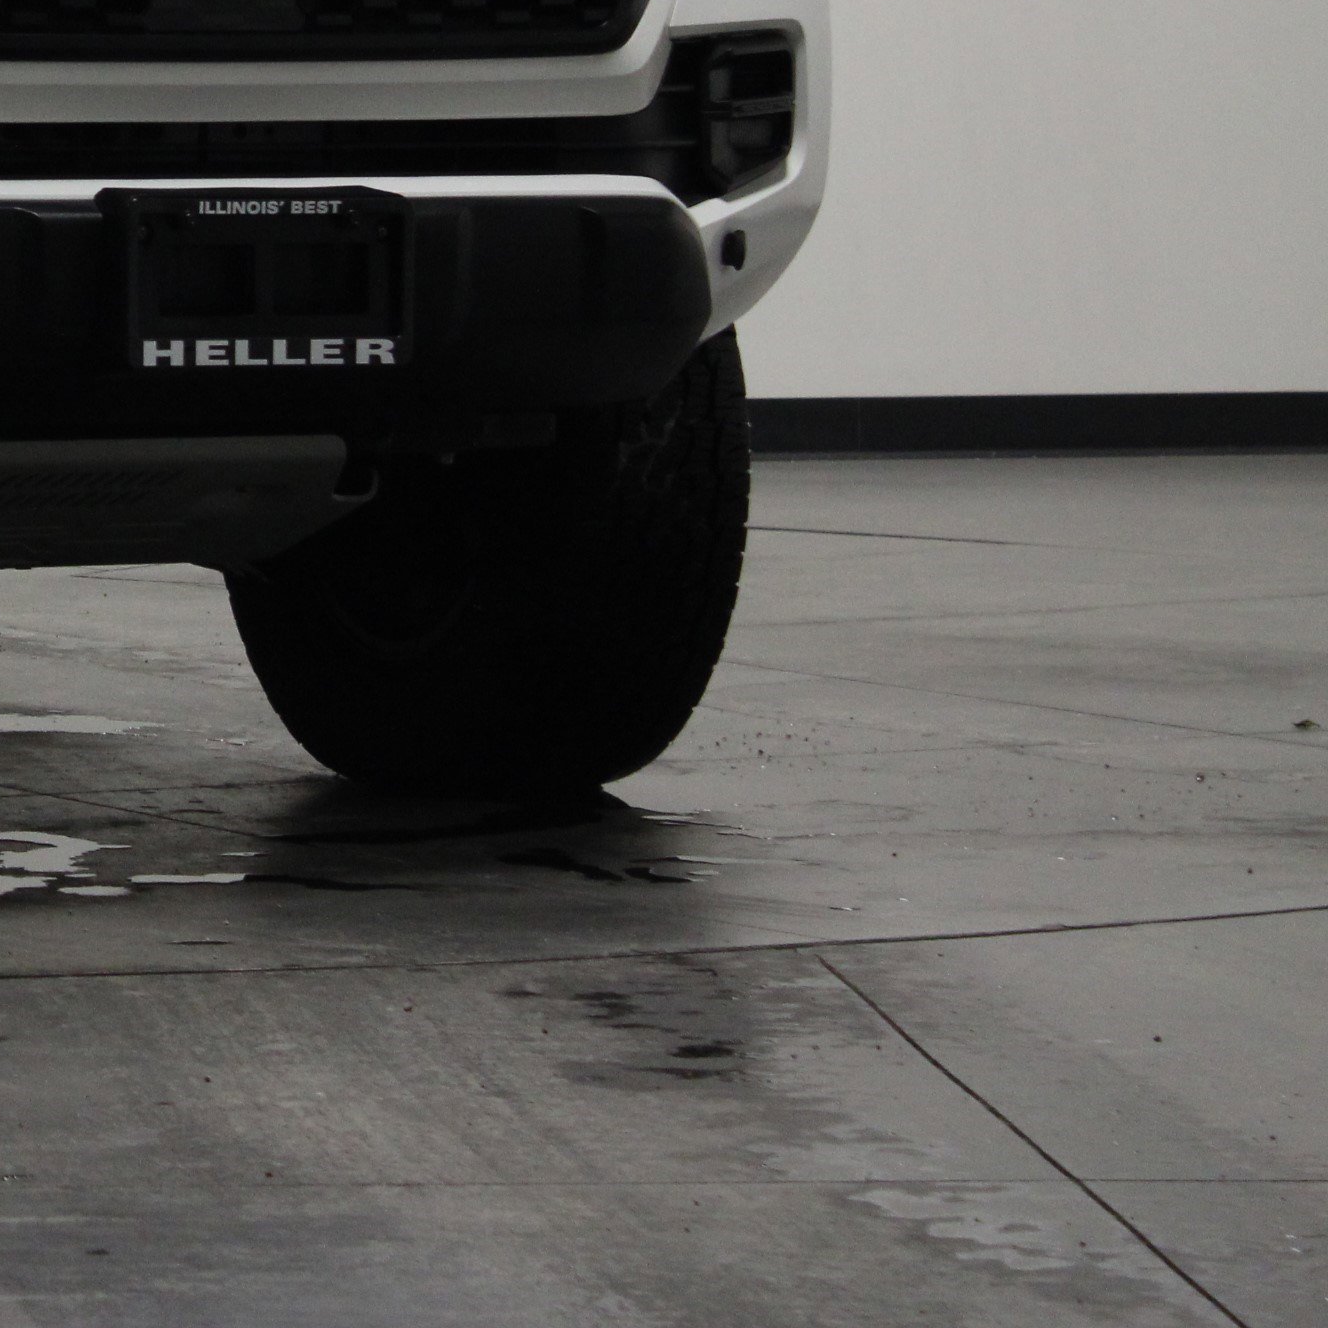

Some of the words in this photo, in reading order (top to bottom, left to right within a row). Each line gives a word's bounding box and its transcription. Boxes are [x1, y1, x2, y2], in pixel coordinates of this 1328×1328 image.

[198, 201, 285, 215] ILLINOIS'
[290, 200, 343, 215] BEST
[142, 338, 396, 367] HELLER
